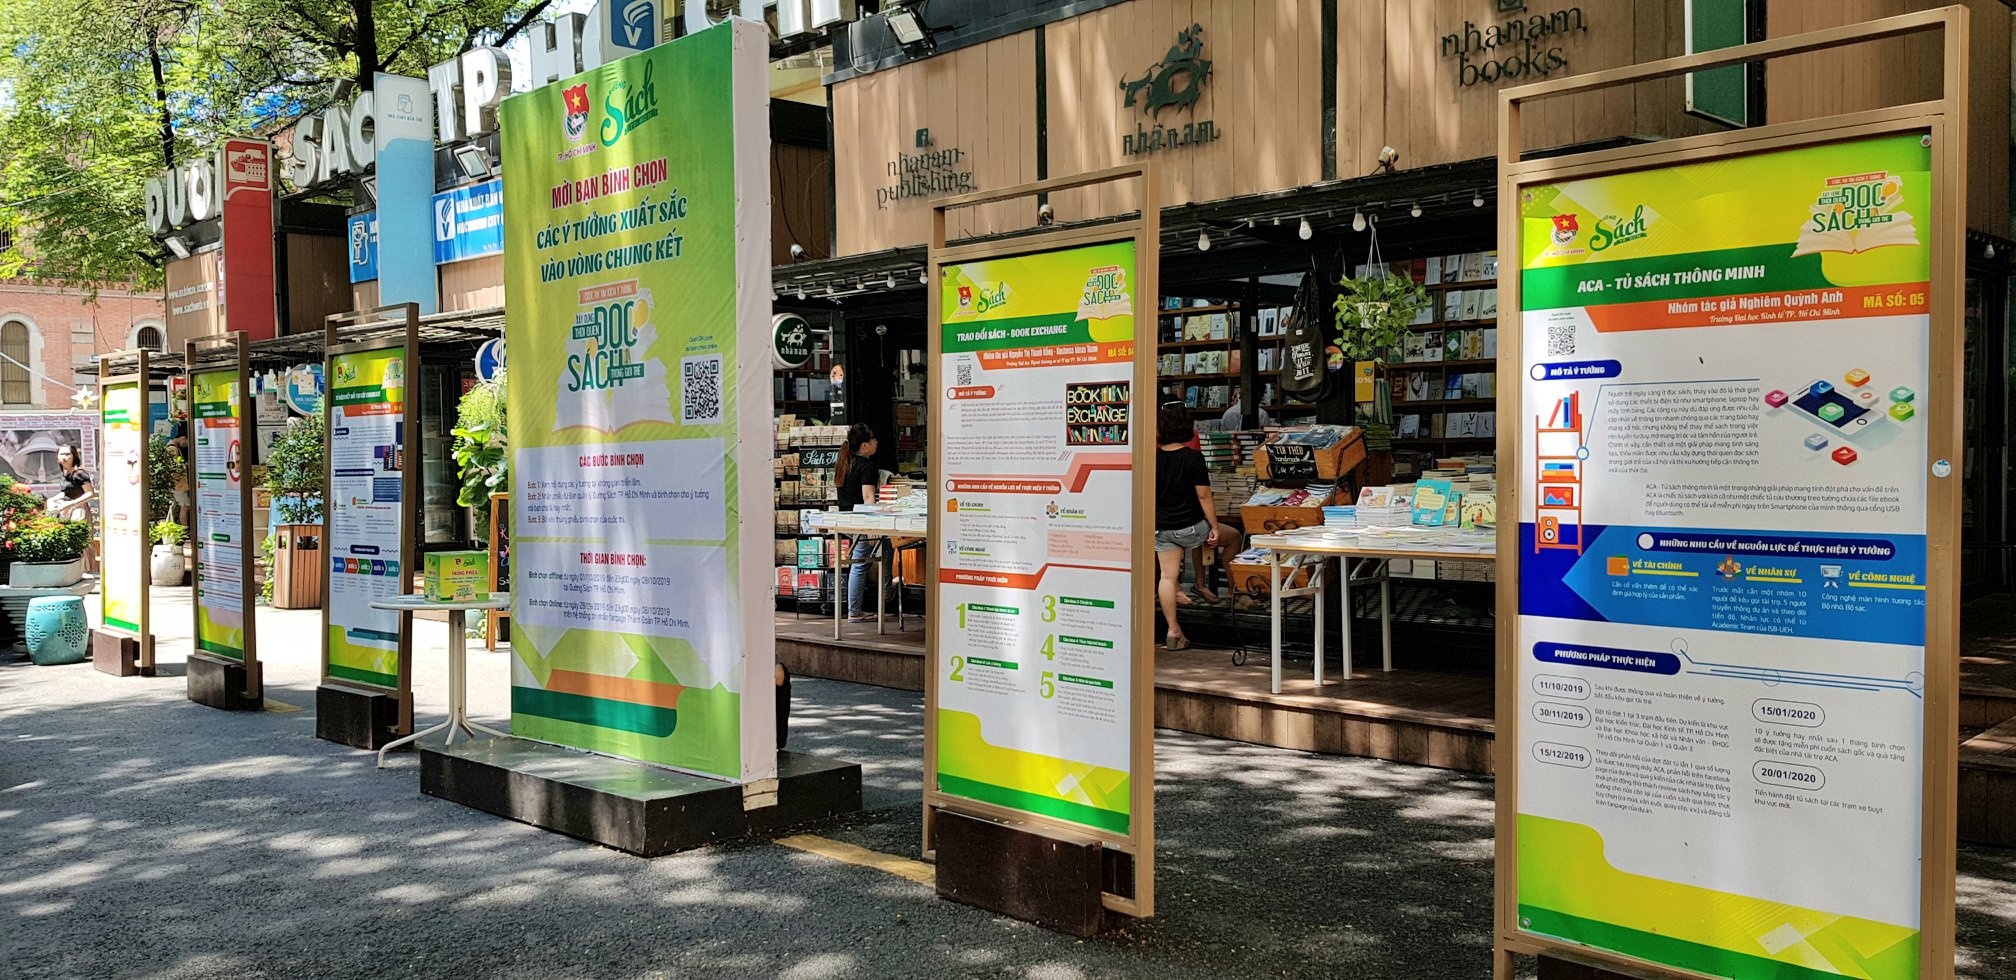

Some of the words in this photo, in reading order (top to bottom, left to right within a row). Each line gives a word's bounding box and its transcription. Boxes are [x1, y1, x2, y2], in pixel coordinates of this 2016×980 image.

[1441, 7, 1587, 56] nhanam
[1459, 39, 1567, 87] books
[600, 58, 658, 147] Sách
[887, 145, 964, 176] nhanam
[551, 183, 572, 209] MỜI
[576, 176, 598, 205] BẠN
[602, 166, 630, 194] BÌNH
[634, 158, 667, 189] CHỌN
[876, 166, 977, 209] publishing
[537, 224, 560, 250] CÁC
[562, 221, 570, 243] Ý
[573, 211, 616, 240] TƯỞNG
[620, 195, 656, 231] XUẤT
[659, 189, 688, 223] SẮC
[1589, 204, 1648, 252] Sách
[541, 254, 565, 282] VÀO
[568, 251, 603, 278] VÒNG
[605, 241, 652, 271] CHUNG
[656, 228, 683, 260] KẾT
[1577, 280, 1604, 293] ACA
[1615, 272, 1632, 290] TỦ
[1634, 271, 1670, 288] SÁCH
[1673, 267, 1722, 284] THÔNG
[1725, 265, 1765, 280] MINH
[1668, 302, 1698, 314] Nhóm
[1700, 300, 1717, 312] tác
[1720, 300, 1736, 312] giả
[1740, 294, 1781, 310] Nghiêm
[1784, 292, 1818, 308] Quỳnh
[1822, 291, 1843, 303] Anh
[1863, 293, 1882, 308] MÃ
[1886, 290, 1906, 308] SỐ:
[1909, 293, 1925, 306] 05
[957, 332, 974, 342] TRAO
[975, 327, 988, 341] ĐỔI
[988, 328, 1006, 340] SÁCH
[1010, 328, 1030, 339] BOOK
[1030, 324, 1068, 336] EXCHANGE
[1067, 387, 1099, 404] BOOK
[1067, 408, 1126, 423] EXCHANGE
[580, 454, 591, 468] CÁC
[592, 454, 608, 467] BƯỚC
[610, 453, 626, 466] BÌNH
[626, 453, 644, 468] CHỌN
[1660, 538, 1688, 548] NHỮNG
[1689, 541, 1707, 549] NHU
[1708, 538, 1725, 550] CẦU
[1726, 540, 1738, 550] VỀ
[1738, 540, 1768, 551] NGUỒN
[1770, 542, 1786, 552] LỰC
[1788, 542, 1800, 552] ĐỂ
[1801, 544, 1825, 555] THỰC
[1826, 544, 1848, 556] HIỆN
[1850, 544, 1856, 554] Ý
[1858, 544, 1890, 556] TƯỞNG
[580, 552, 594, 564] THỜI
[594, 552, 609, 565] GIAN
[610, 552, 625, 566] BÌNH
[1632, 558, 1642, 568] VỀ
[1643, 560, 1656, 568] TÀI
[1657, 561, 1682, 570] CHÍNH
[1746, 565, 1756, 575] VỀ
[1758, 566, 1783, 576] NHÂN
[1784, 568, 1797, 578] SỰ
[1848, 570, 1860, 580] VỀ
[1862, 572, 1888, 582] CÔNG
[1890, 574, 1916, 584] NGHỆ
[955, 602, 966, 629] 1
[1041, 594, 1056, 622] 3
[1040, 633, 1055, 660] 4
[949, 655, 964, 682] 2
[1554, 649, 1588, 660] PHƯƠNG
[1588, 652, 1610, 662] PHÁP
[1612, 655, 1634, 666] THỰC
[1635, 657, 1656, 668] HIỆN
[1039, 670, 1055, 699] 5
[1540, 681, 1583, 694] 11/10/2019
[1540, 708, 1584, 722] 30/11/2019
[1760, 706, 1816, 720] 15/01/2020
[1540, 747, 1584, 762] 15/12/2019
[1761, 768, 1816, 784] 20/01/2020
